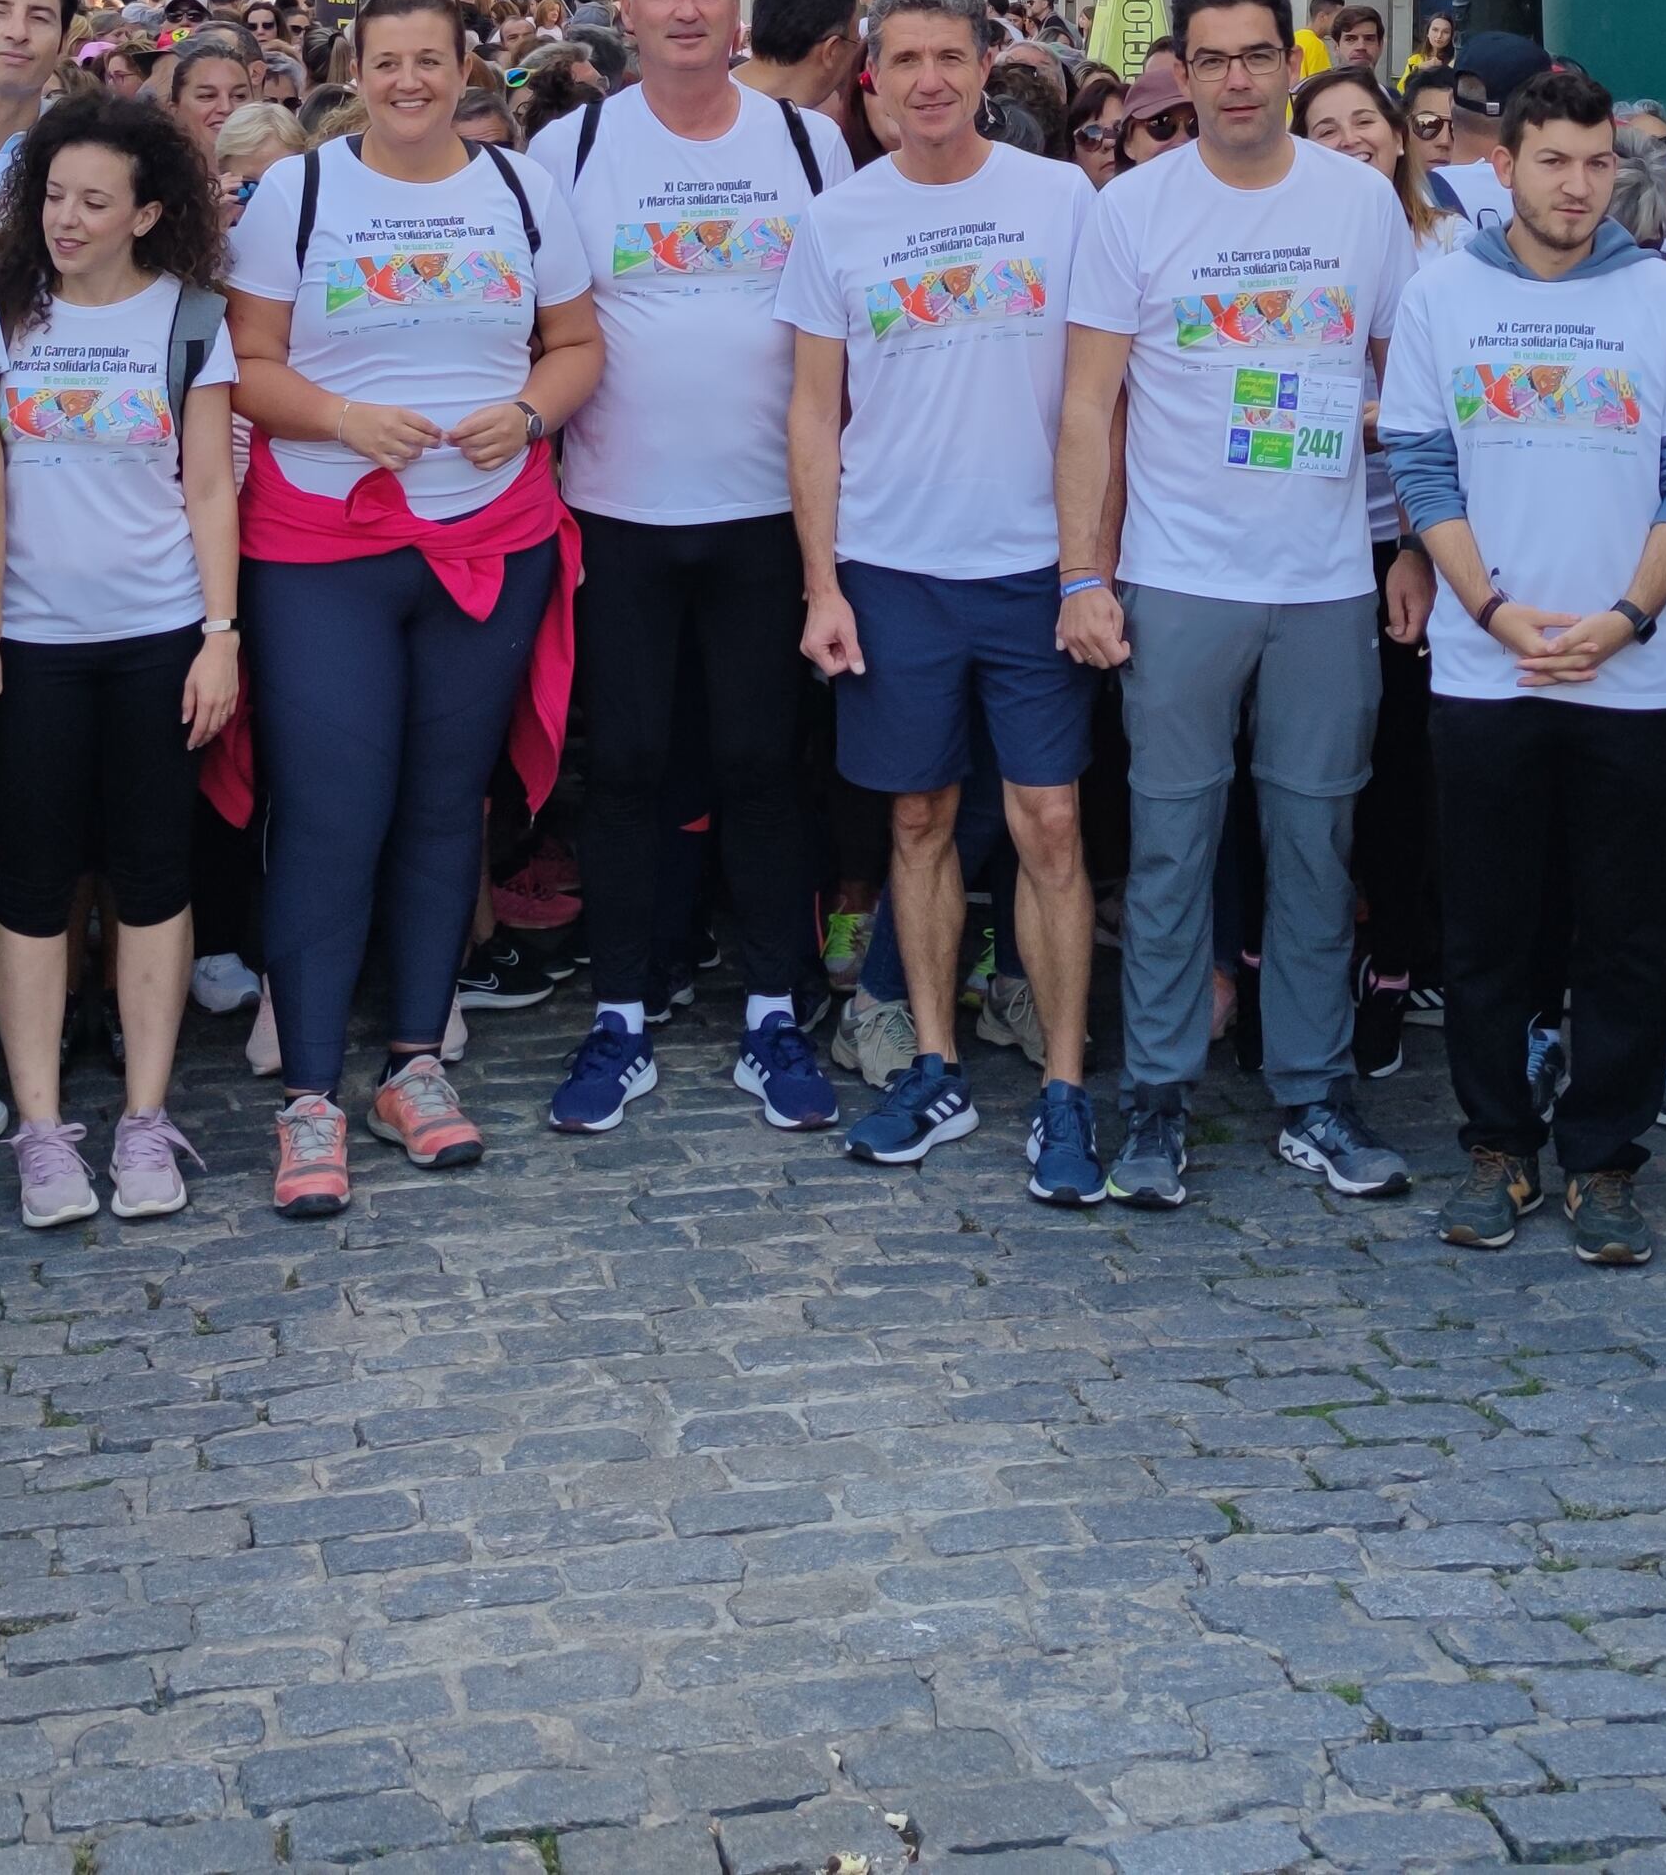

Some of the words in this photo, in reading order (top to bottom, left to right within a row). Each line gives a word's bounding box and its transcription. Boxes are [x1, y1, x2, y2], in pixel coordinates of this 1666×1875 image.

[664, 182, 674, 192] XI
[677, 181, 714, 192] Carrera
[716, 179, 752, 192] popular
[639, 198, 645, 209] y
[647, 195, 684, 207] Marcha
[687, 193, 729, 205] solidaria
[731, 192, 752, 205] Caja
[753, 190, 778, 202] Rural
[371, 218, 382, 229] XI
[385, 217, 425, 229] Carrera
[427, 216, 465, 227] popular
[347, 233, 353, 244] y
[355, 231, 396, 242] Marcha
[398, 228, 442, 241] solidaria
[444, 227, 467, 239] Caja
[469, 225, 495, 237] Rural
[906, 235, 916, 247] XI
[919, 226, 957, 242] Carrera
[959, 221, 997, 235] popular
[883, 257, 889, 268] y
[891, 247, 929, 264] Marcha
[930, 238, 973, 254] solidaria
[974, 234, 997, 247] Caja
[998, 231, 1025, 244] Rural
[1217, 251, 1228, 264] XI
[1231, 249, 1271, 263] Carrera
[1273, 245, 1312, 261] popular
[1192, 268, 1198, 280] y
[1200, 265, 1241, 278] Marcha
[1243, 261, 1288, 276] solidaria
[1289, 261, 1313, 272] Caja
[1314, 257, 1340, 270] Rural
[1497, 322, 1508, 334] XI
[1511, 322, 1553, 334] Carrera
[1555, 324, 1596, 336] popular
[31, 346, 41, 358] XI
[44, 346, 85, 358] Carrera
[88, 345, 130, 359] popular
[1469, 338, 1476, 349] y
[1478, 336, 1519, 347] Marcha
[1521, 336, 1567, 348] solidaria
[1569, 337, 1594, 350] Caja
[1595, 338, 1624, 352] Rural
[12, 361, 50, 372] Marcha
[53, 361, 101, 373] solidaria
[102, 361, 127, 373] Caja
[129, 361, 157, 374] Rural
[1297, 426, 1343, 459] 2441
